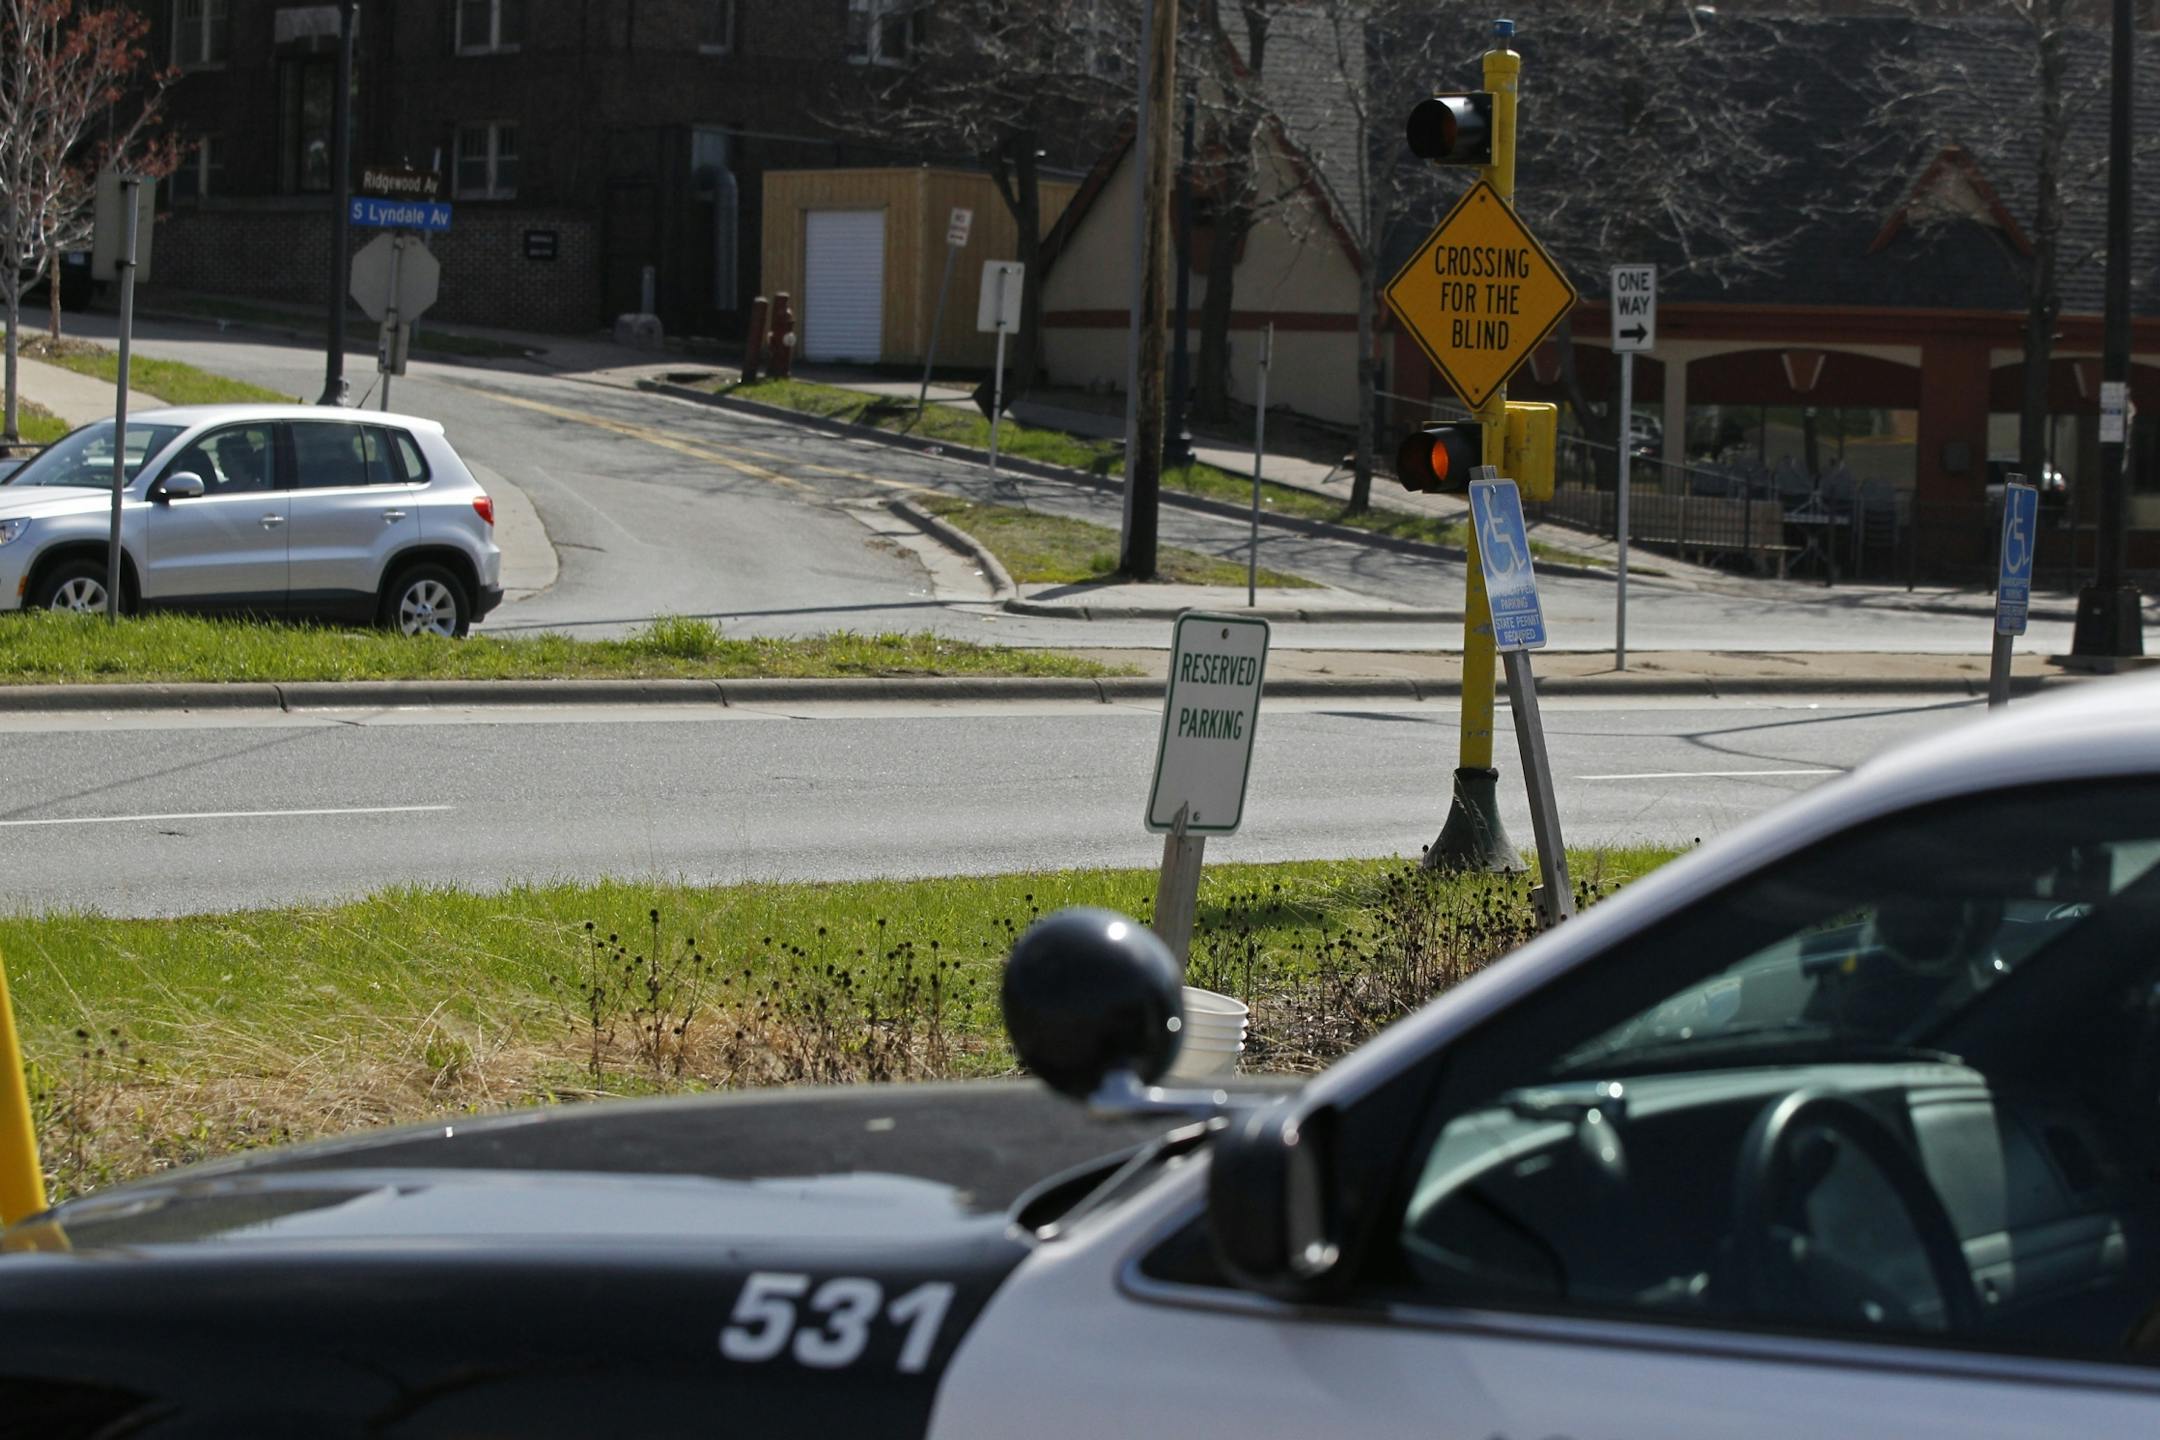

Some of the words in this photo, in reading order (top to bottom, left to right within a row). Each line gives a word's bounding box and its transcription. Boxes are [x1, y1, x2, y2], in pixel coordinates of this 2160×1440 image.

[363, 171, 421, 195] Ridgewood
[423, 177, 439, 193] Av
[353, 203, 363, 220] S
[369, 204, 424, 225] Lyndale
[431, 208, 449, 225] Av
[1435, 245, 1529, 278] CROSSING
[1618, 272, 1650, 291] ONE
[1441, 282, 1477, 313] FOR
[1486, 284, 1520, 315] THE
[1617, 296, 1650, 315] WAY
[1452, 319, 1509, 350] BLIND
[1501, 596, 1529, 610] PARKING
[1495, 616, 1516, 630] STATE
[1516, 614, 1540, 628] PERMIT
[1504, 628, 1536, 642] REQUIRED
[1180, 652, 1257, 686] RESERVED
[1178, 707, 1244, 740] PARKING
[718, 1271, 956, 1372] 531
